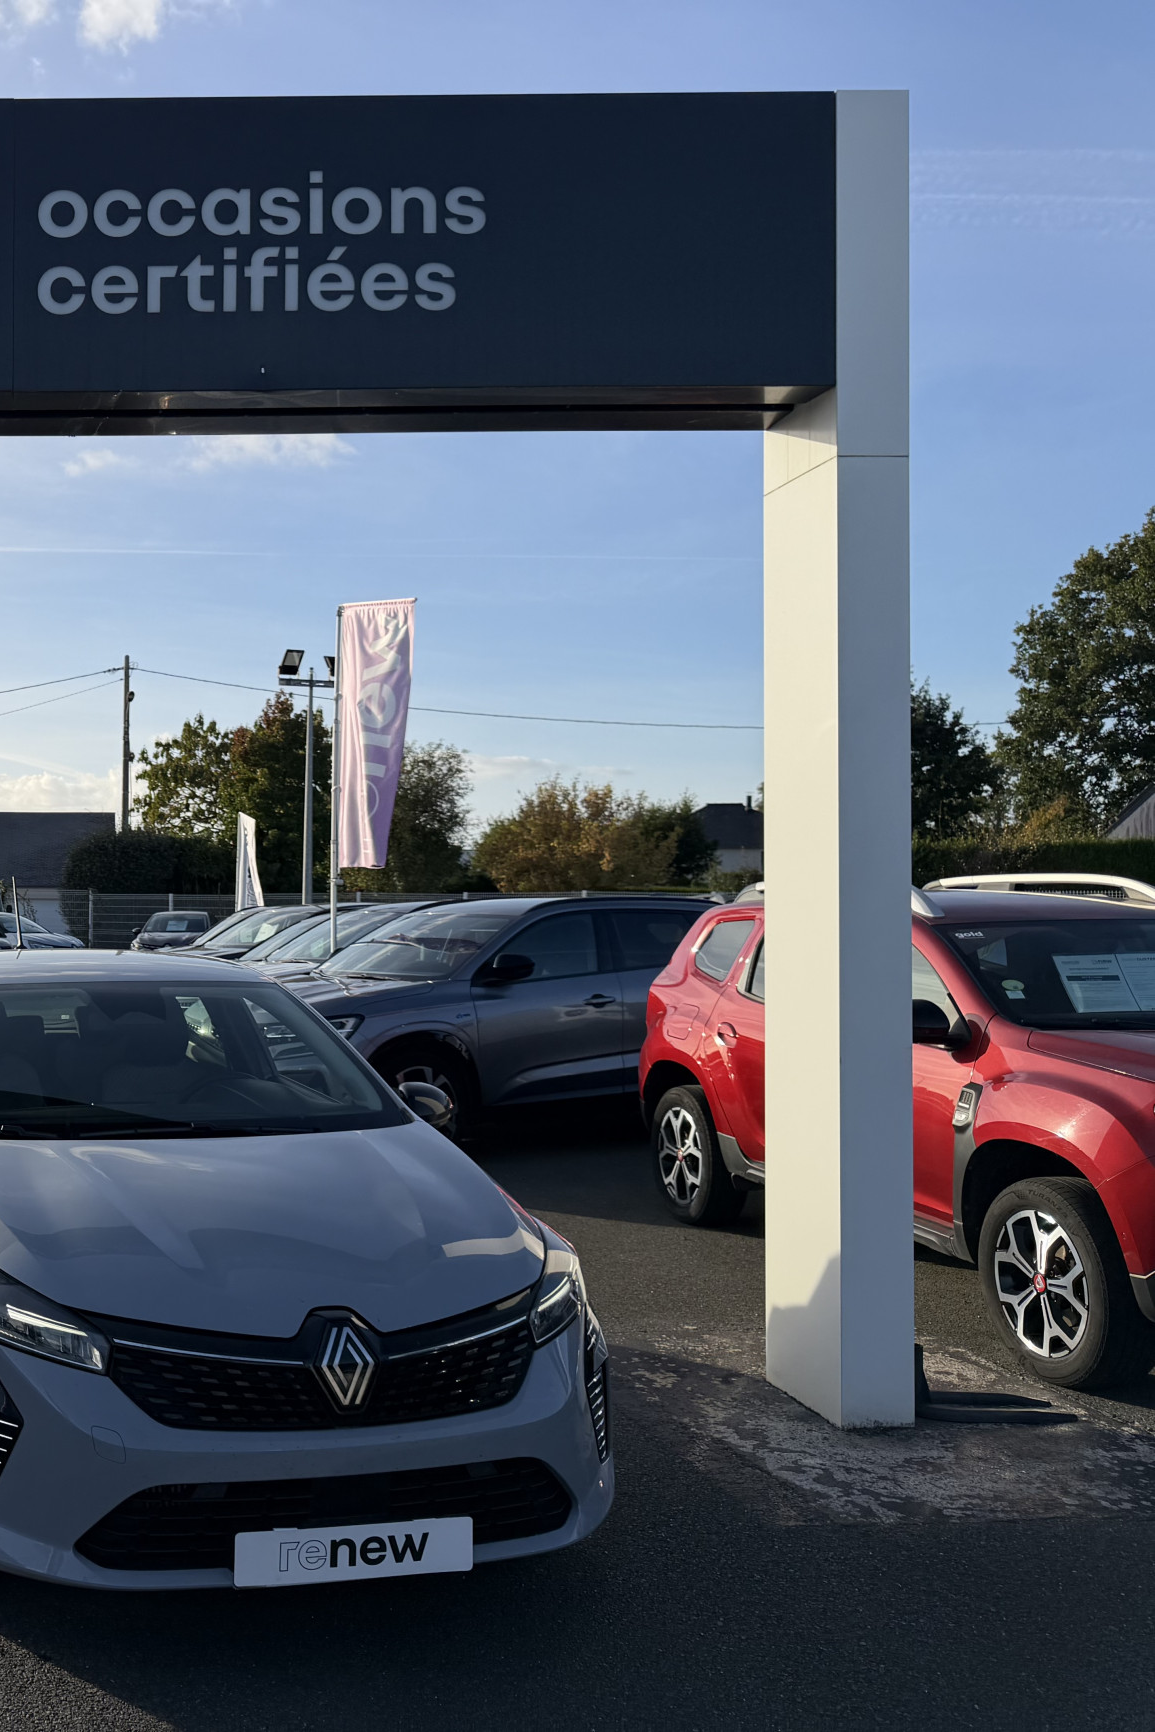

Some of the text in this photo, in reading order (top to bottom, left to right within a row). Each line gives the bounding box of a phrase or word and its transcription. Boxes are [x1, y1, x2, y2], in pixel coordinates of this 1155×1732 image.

[37, 170, 487, 238] occasions
[37, 246, 457, 315] certifiées
[357, 614, 408, 854] new
[955, 931, 984, 939] gold
[278, 1531, 430, 1572] renew
